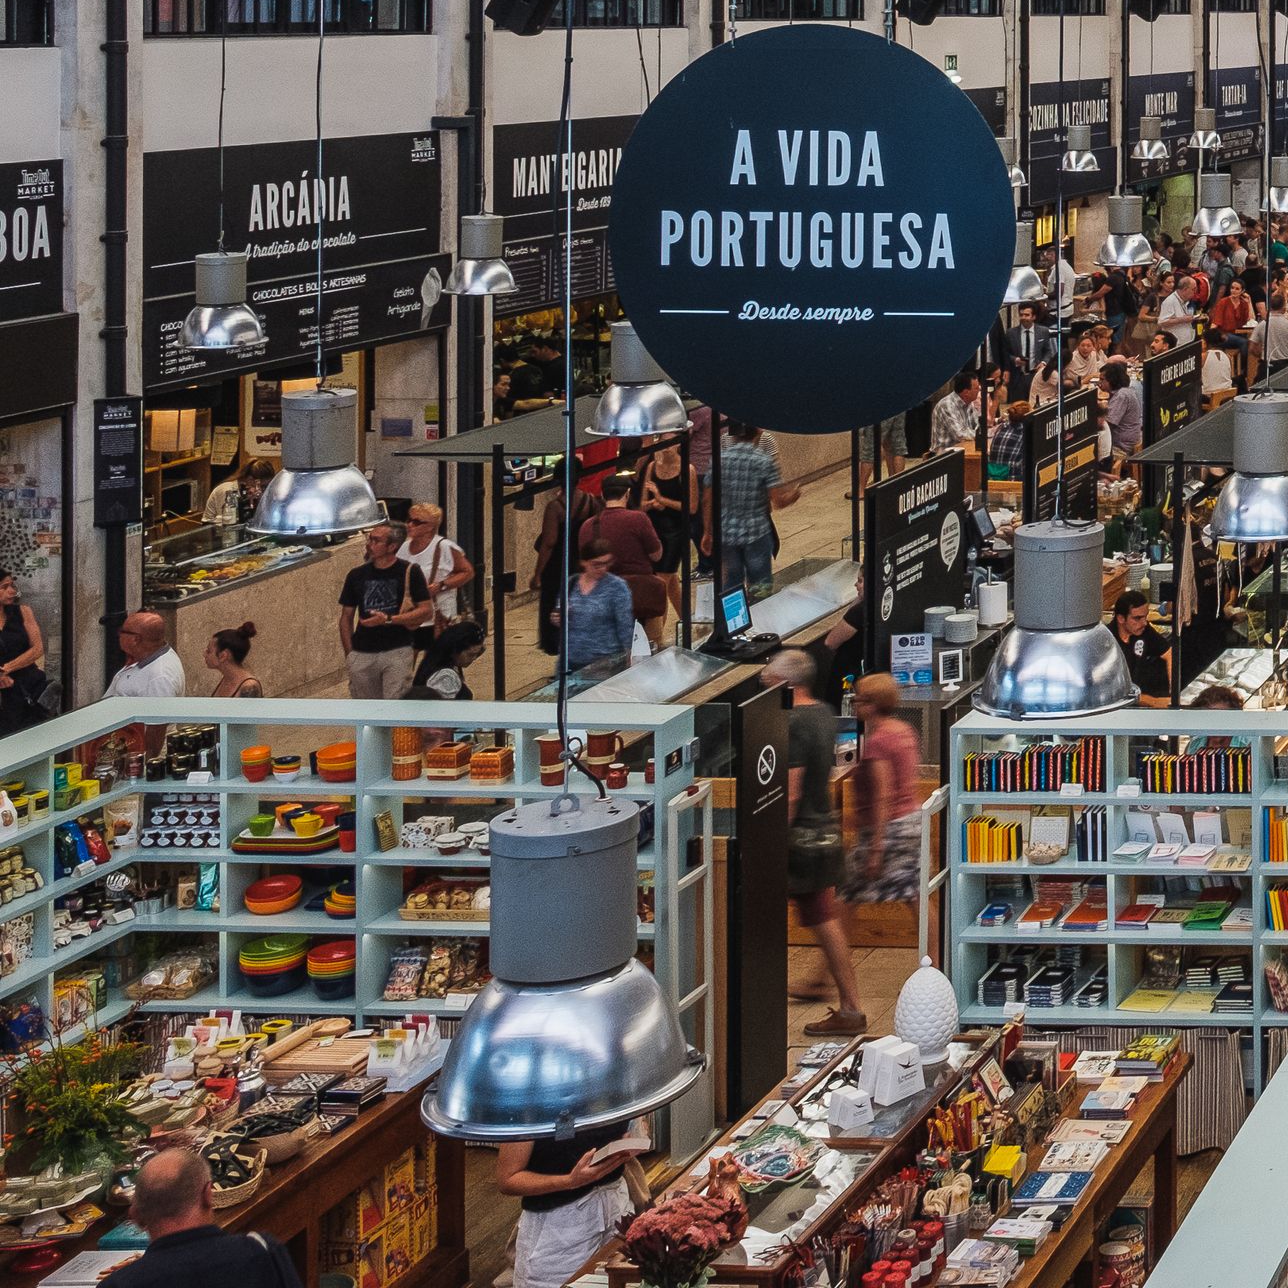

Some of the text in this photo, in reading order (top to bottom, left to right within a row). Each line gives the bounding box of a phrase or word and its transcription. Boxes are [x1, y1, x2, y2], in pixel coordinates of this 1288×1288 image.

[1276, 80, 1285, 99] CAF
[1028, 103, 1058, 131] COZINHA
[1072, 99, 1109, 126] FELICIDADE
[730, 130, 885, 187] A VIDA
[17, 185, 55, 196] MARKET
[249, 170, 351, 232] ARCÁDIA
[576, 197, 599, 212] Desde
[252, 240, 295, 259] tradição
[297, 238, 310, 252] do
[311, 231, 357, 250] chocolate
[659, 210, 955, 270] PORTUGUESA
[252, 274, 367, 301] CHOCOLATES E BOLS ARTESANAIS
[738, 301, 875, 326] Desde sempre
[916, 474, 948, 506] BACALHAU
